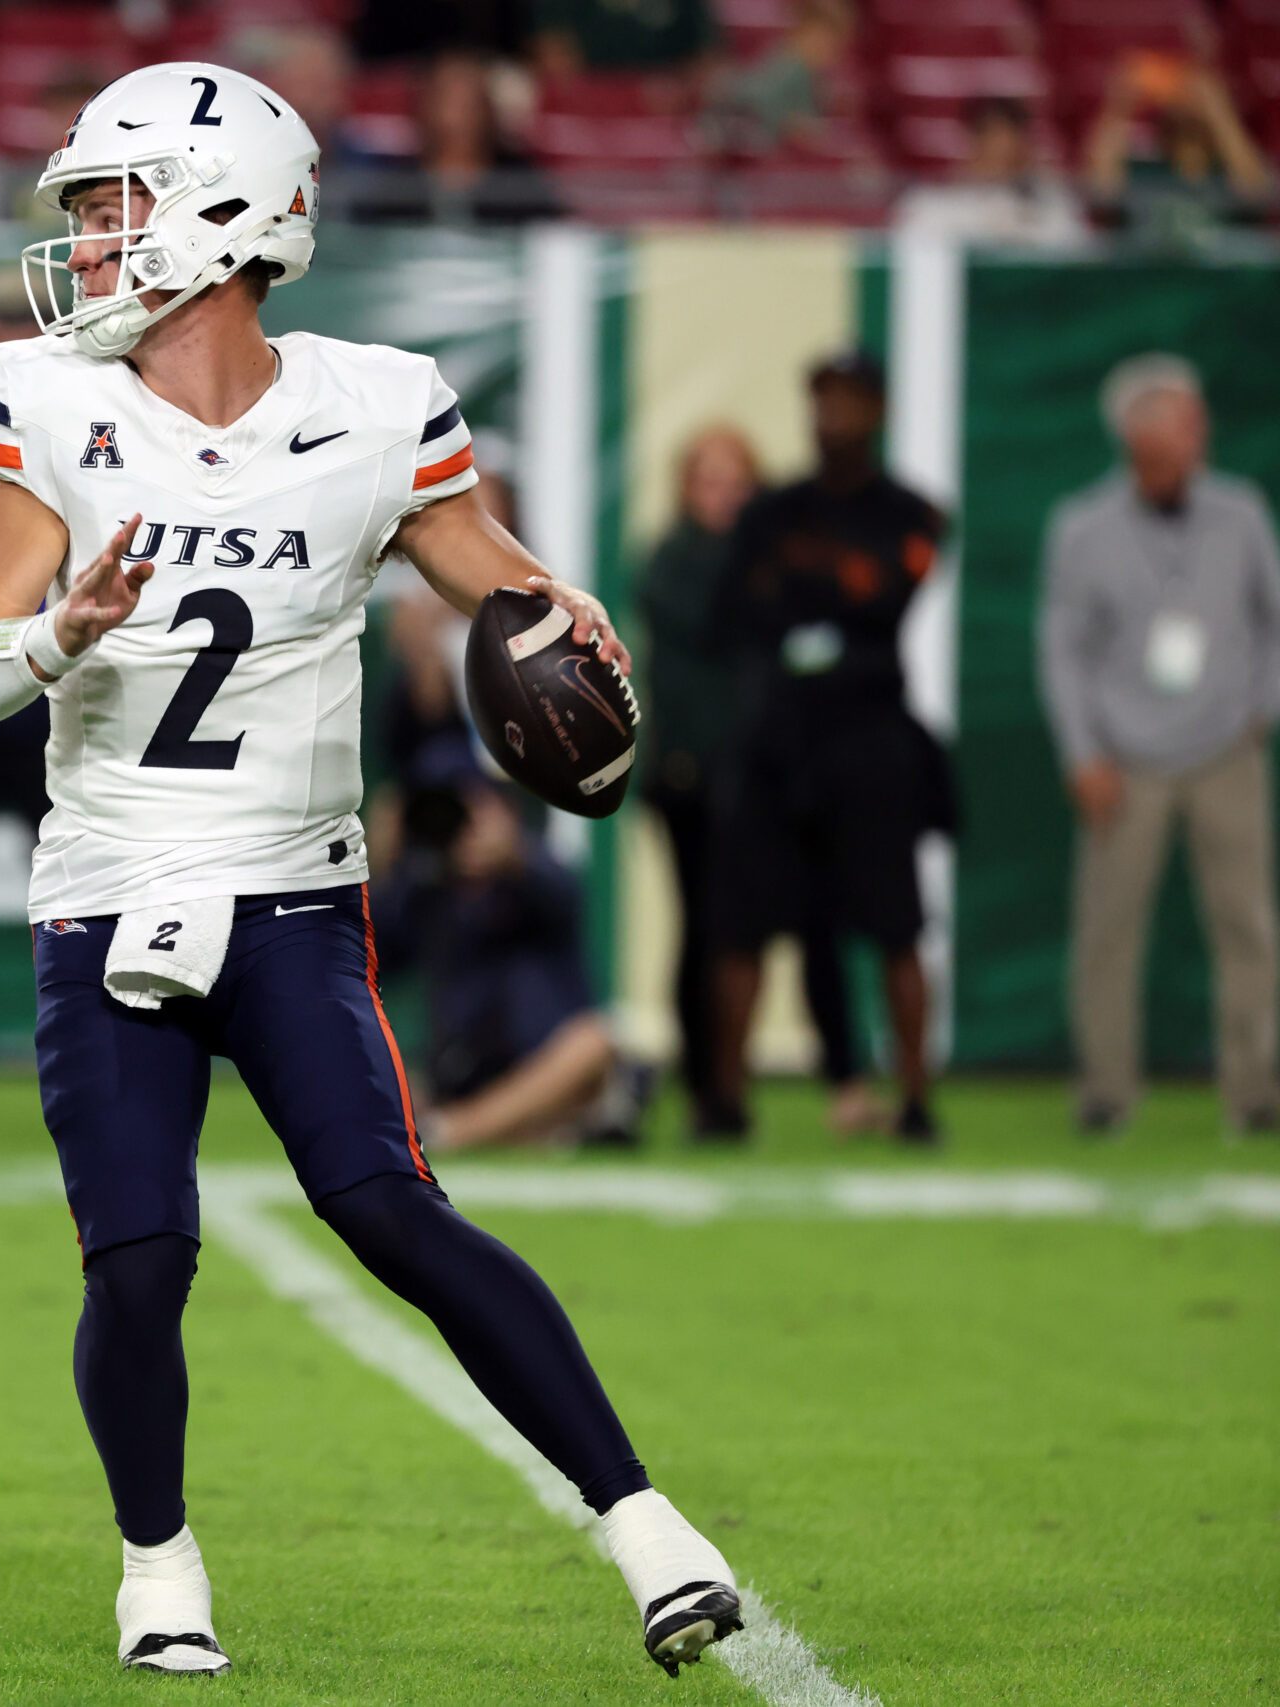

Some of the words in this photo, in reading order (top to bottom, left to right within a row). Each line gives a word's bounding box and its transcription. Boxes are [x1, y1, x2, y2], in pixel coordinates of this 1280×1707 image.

[189, 77, 223, 127] 2
[118, 519, 311, 571] UTSA
[138, 586, 254, 770] 2
[148, 920, 184, 952] 2
